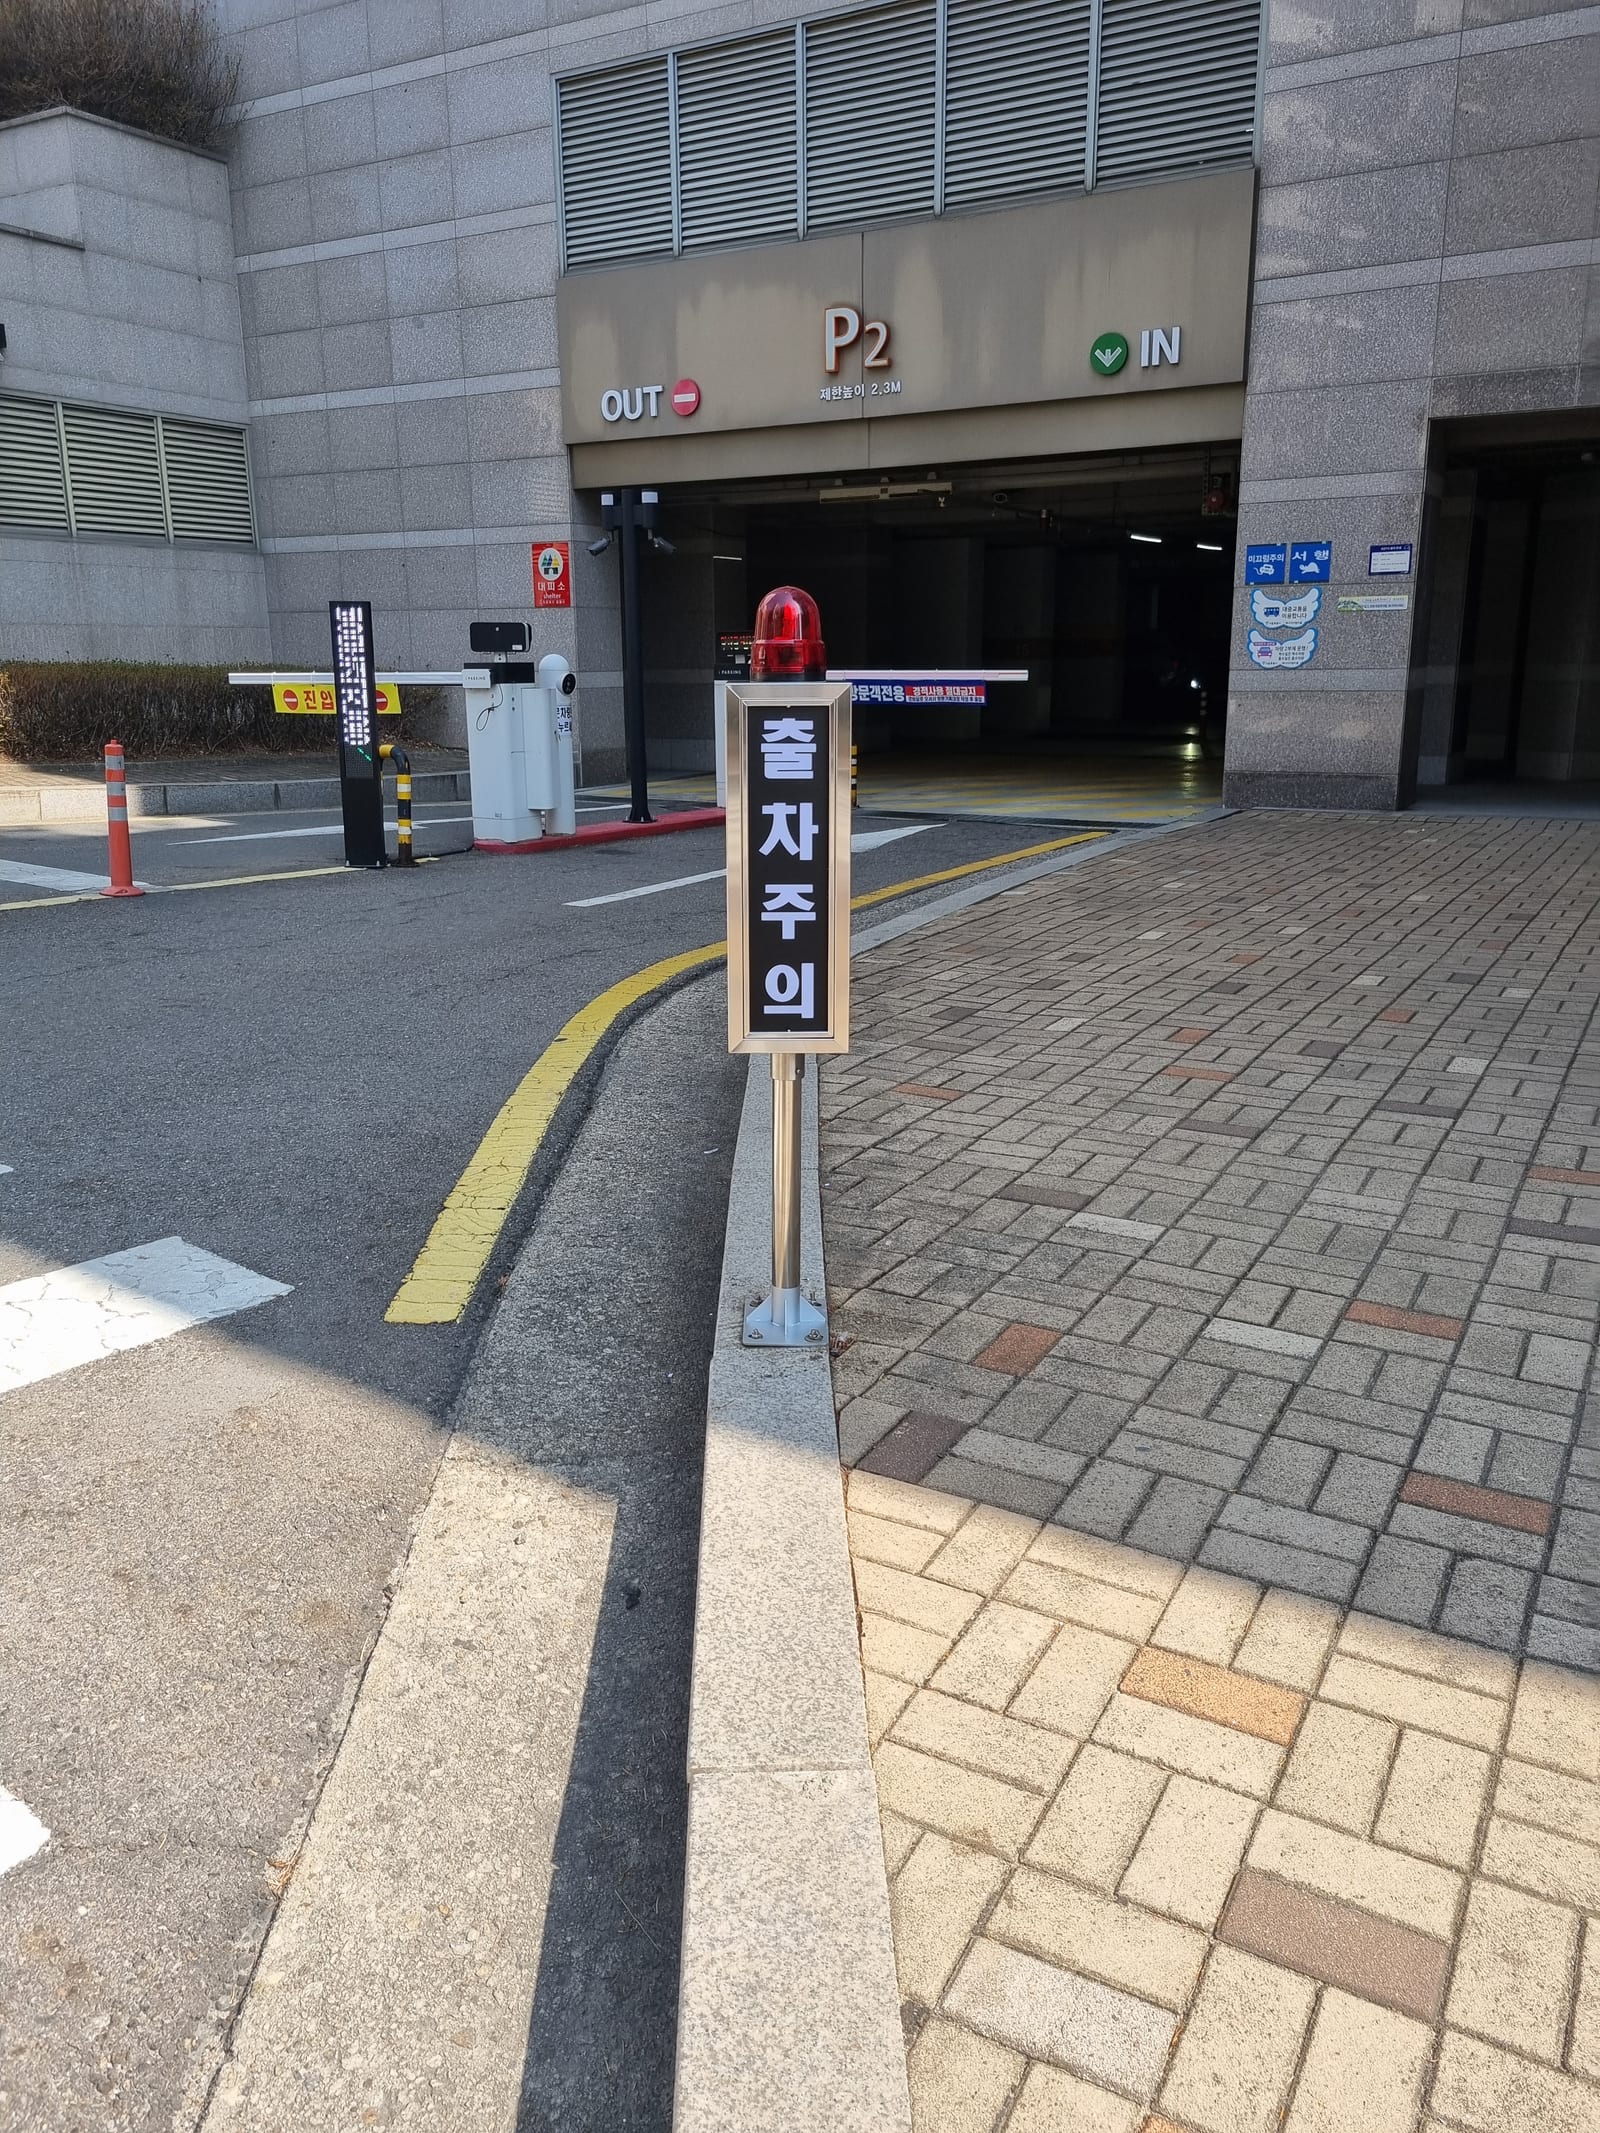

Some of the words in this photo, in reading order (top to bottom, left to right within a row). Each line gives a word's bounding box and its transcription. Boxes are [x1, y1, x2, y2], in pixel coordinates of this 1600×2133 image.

[824, 306, 891, 373] P2
[1140, 326, 1181, 368] IN
[601, 385, 664, 422] OUT
[820, 384, 865, 400] 제한높이
[871, 381, 901, 395] 2.3M
[1248, 553, 1284, 563] 미끄럼주의
[758, 717, 819, 1019] 출차주의
